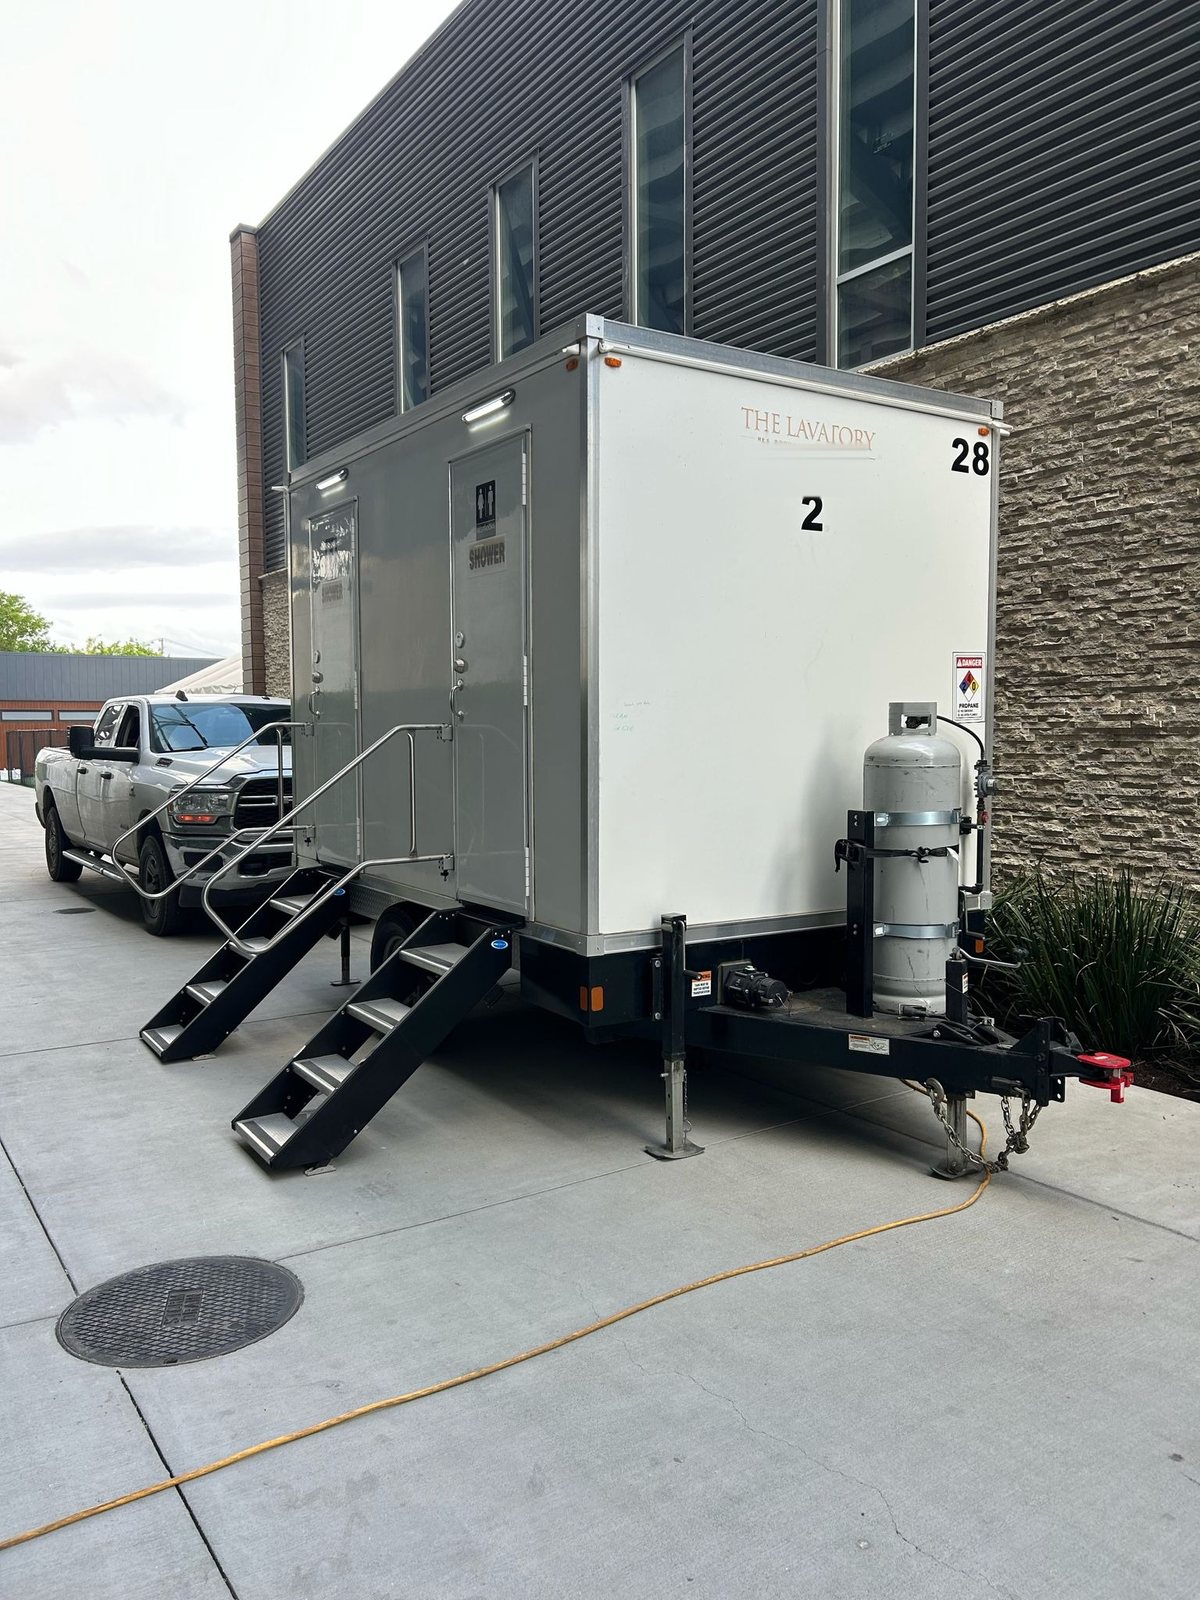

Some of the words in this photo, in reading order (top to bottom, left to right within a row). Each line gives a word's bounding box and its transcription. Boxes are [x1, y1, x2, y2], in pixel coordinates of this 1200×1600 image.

[741, 406, 781, 434] THE
[787, 416, 876, 451] LAVATORY
[951, 437, 990, 476] 28
[801, 496, 824, 532] 2
[469, 542, 505, 570] SHOWER
[962, 659, 982, 667] DANGER
